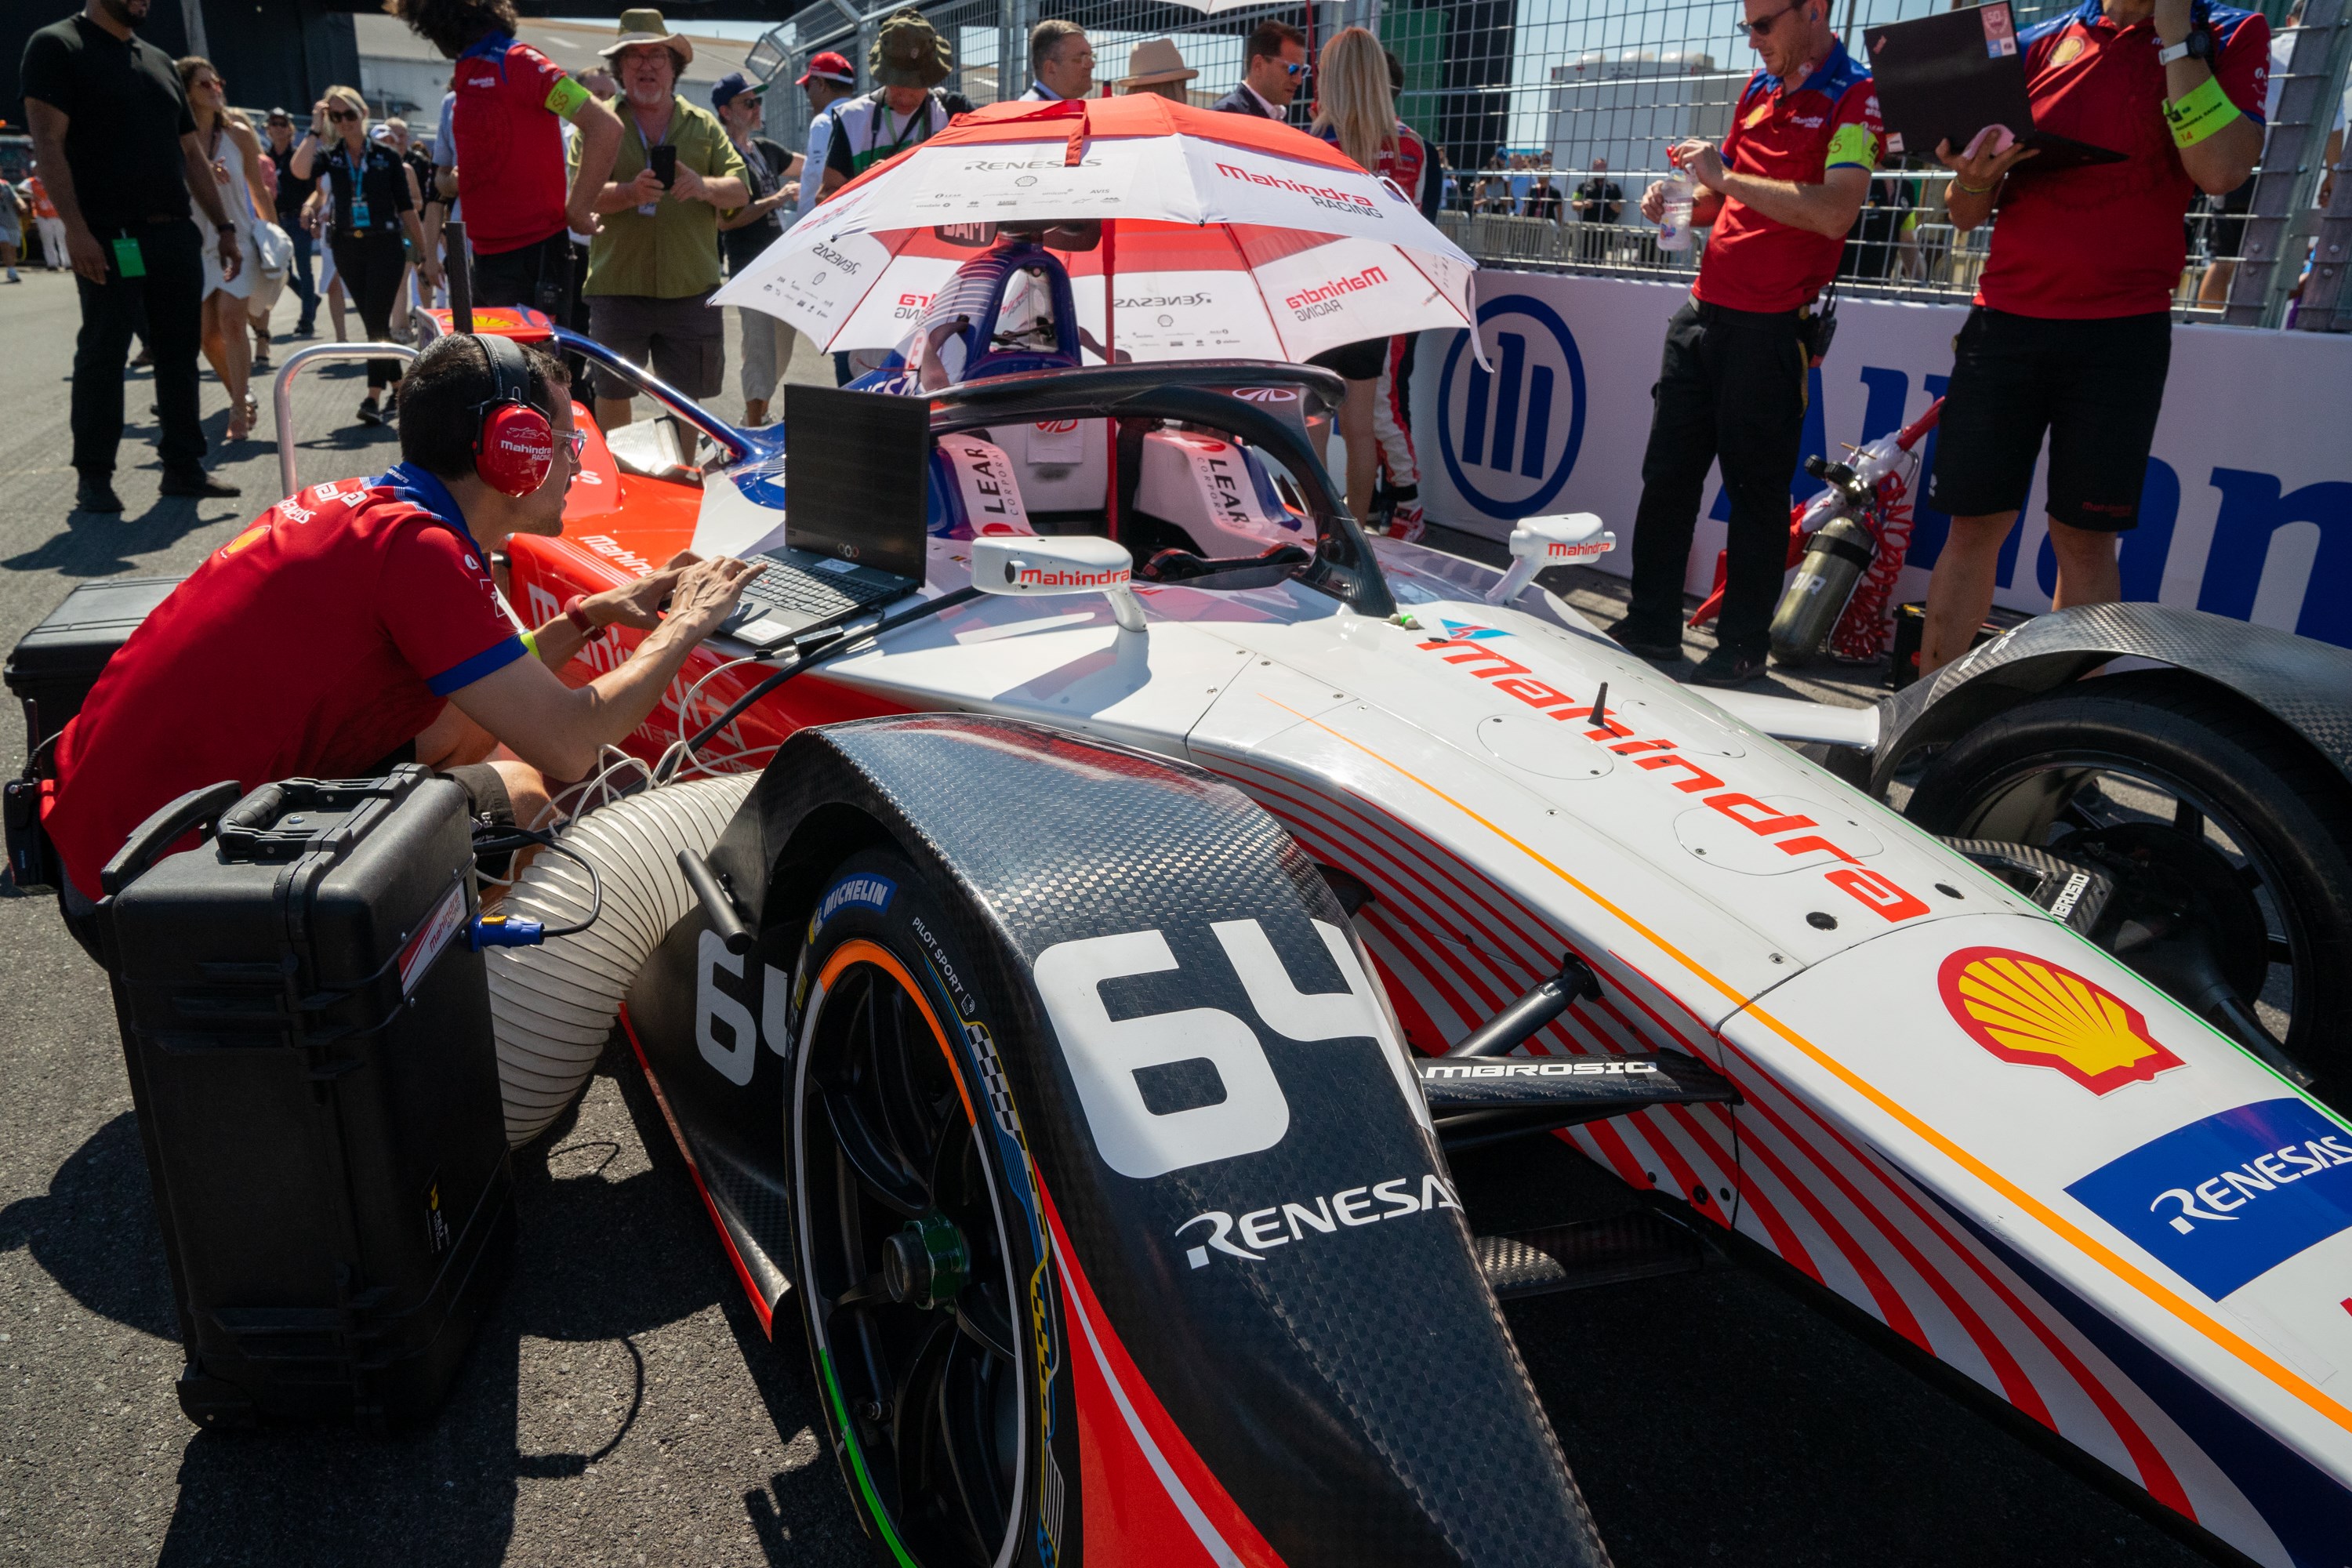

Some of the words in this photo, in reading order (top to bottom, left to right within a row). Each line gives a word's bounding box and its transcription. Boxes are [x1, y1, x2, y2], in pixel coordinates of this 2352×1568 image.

[964, 158, 1103, 172] RENESS
[1214, 162, 1374, 207] Mahindra
[1310, 195, 1384, 219] RACING
[500, 440, 552, 455] Mahindra
[964, 448, 1006, 514] LEAR
[1208, 459, 1250, 523] LEAR
[578, 535, 654, 577] Mahin
[1548, 541, 1610, 557] Mahindra
[1021, 568, 1130, 586] Mahindra
[1415, 638, 1930, 923] Mahindra
[823, 880, 888, 919] MICHELIN
[912, 916, 937, 948] PILOT
[935, 948, 964, 993] SPORT
[1033, 919, 1437, 1178] 64
[1415, 1062, 1657, 1079] MBROSIO
[2150, 1135, 2352, 1236] RENESAS
